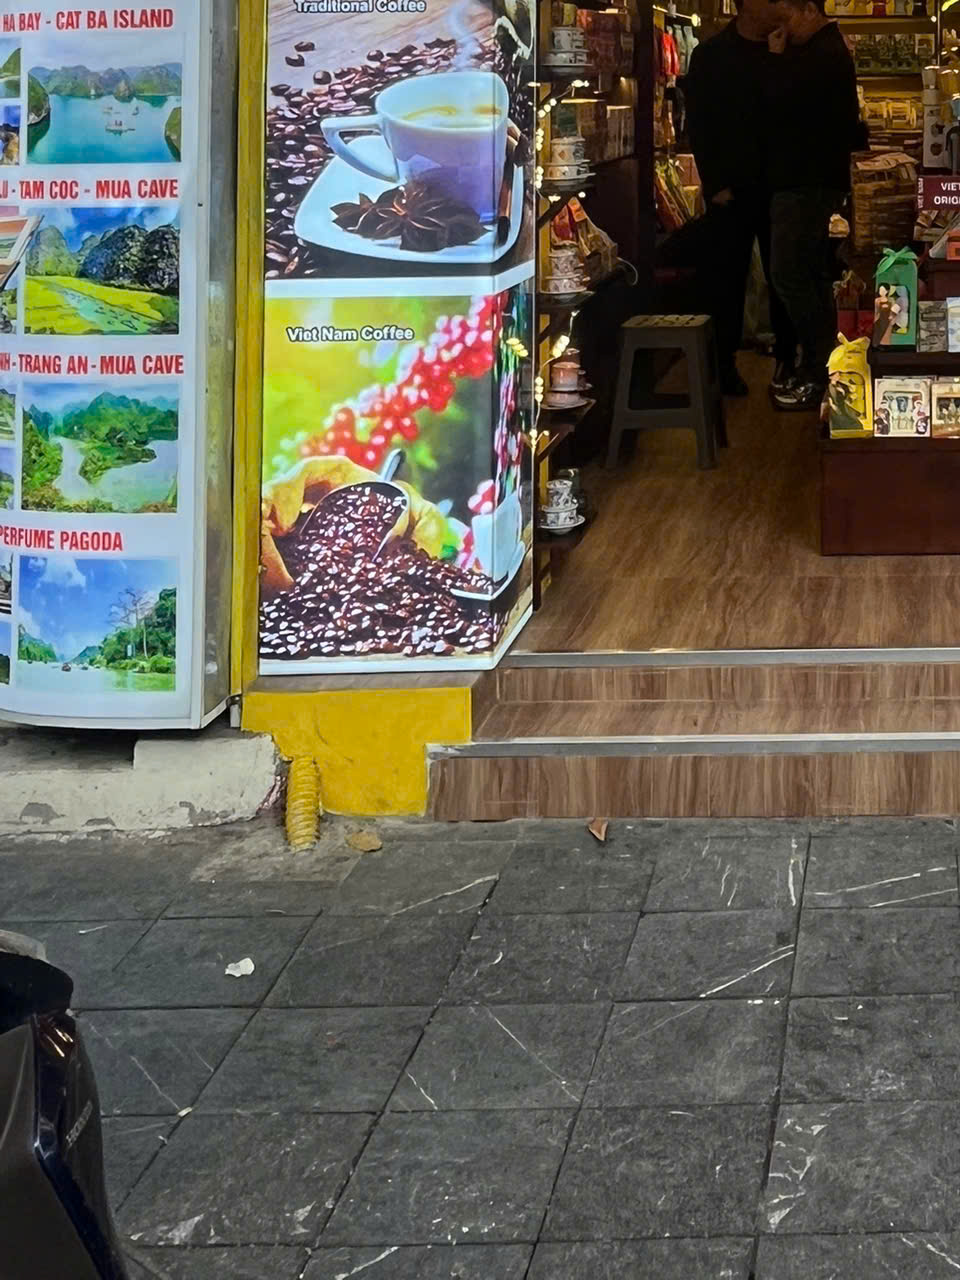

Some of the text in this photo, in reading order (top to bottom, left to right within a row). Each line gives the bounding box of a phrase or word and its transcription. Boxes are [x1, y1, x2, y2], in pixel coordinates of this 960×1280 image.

[19, 12, 42, 31] BAY
[56, 10, 82, 30] CAT
[86, 10, 108, 29] BA
[114, 8, 174, 29] ISLAND
[20, 180, 45, 200] TAM
[49, 180, 79, 200] COC
[95, 179, 132, 199] MUA
[137, 179, 179, 199] CAVE
[286, 325, 415, 342] Viet Nam Coffee
[19, 353, 62, 374] TRANG
[66, 355, 89, 374] AN
[100, 355, 137, 375] MUA
[142, 355, 184, 374] CAVE
[0, 525, 123, 551] PERFUME PAGODA
